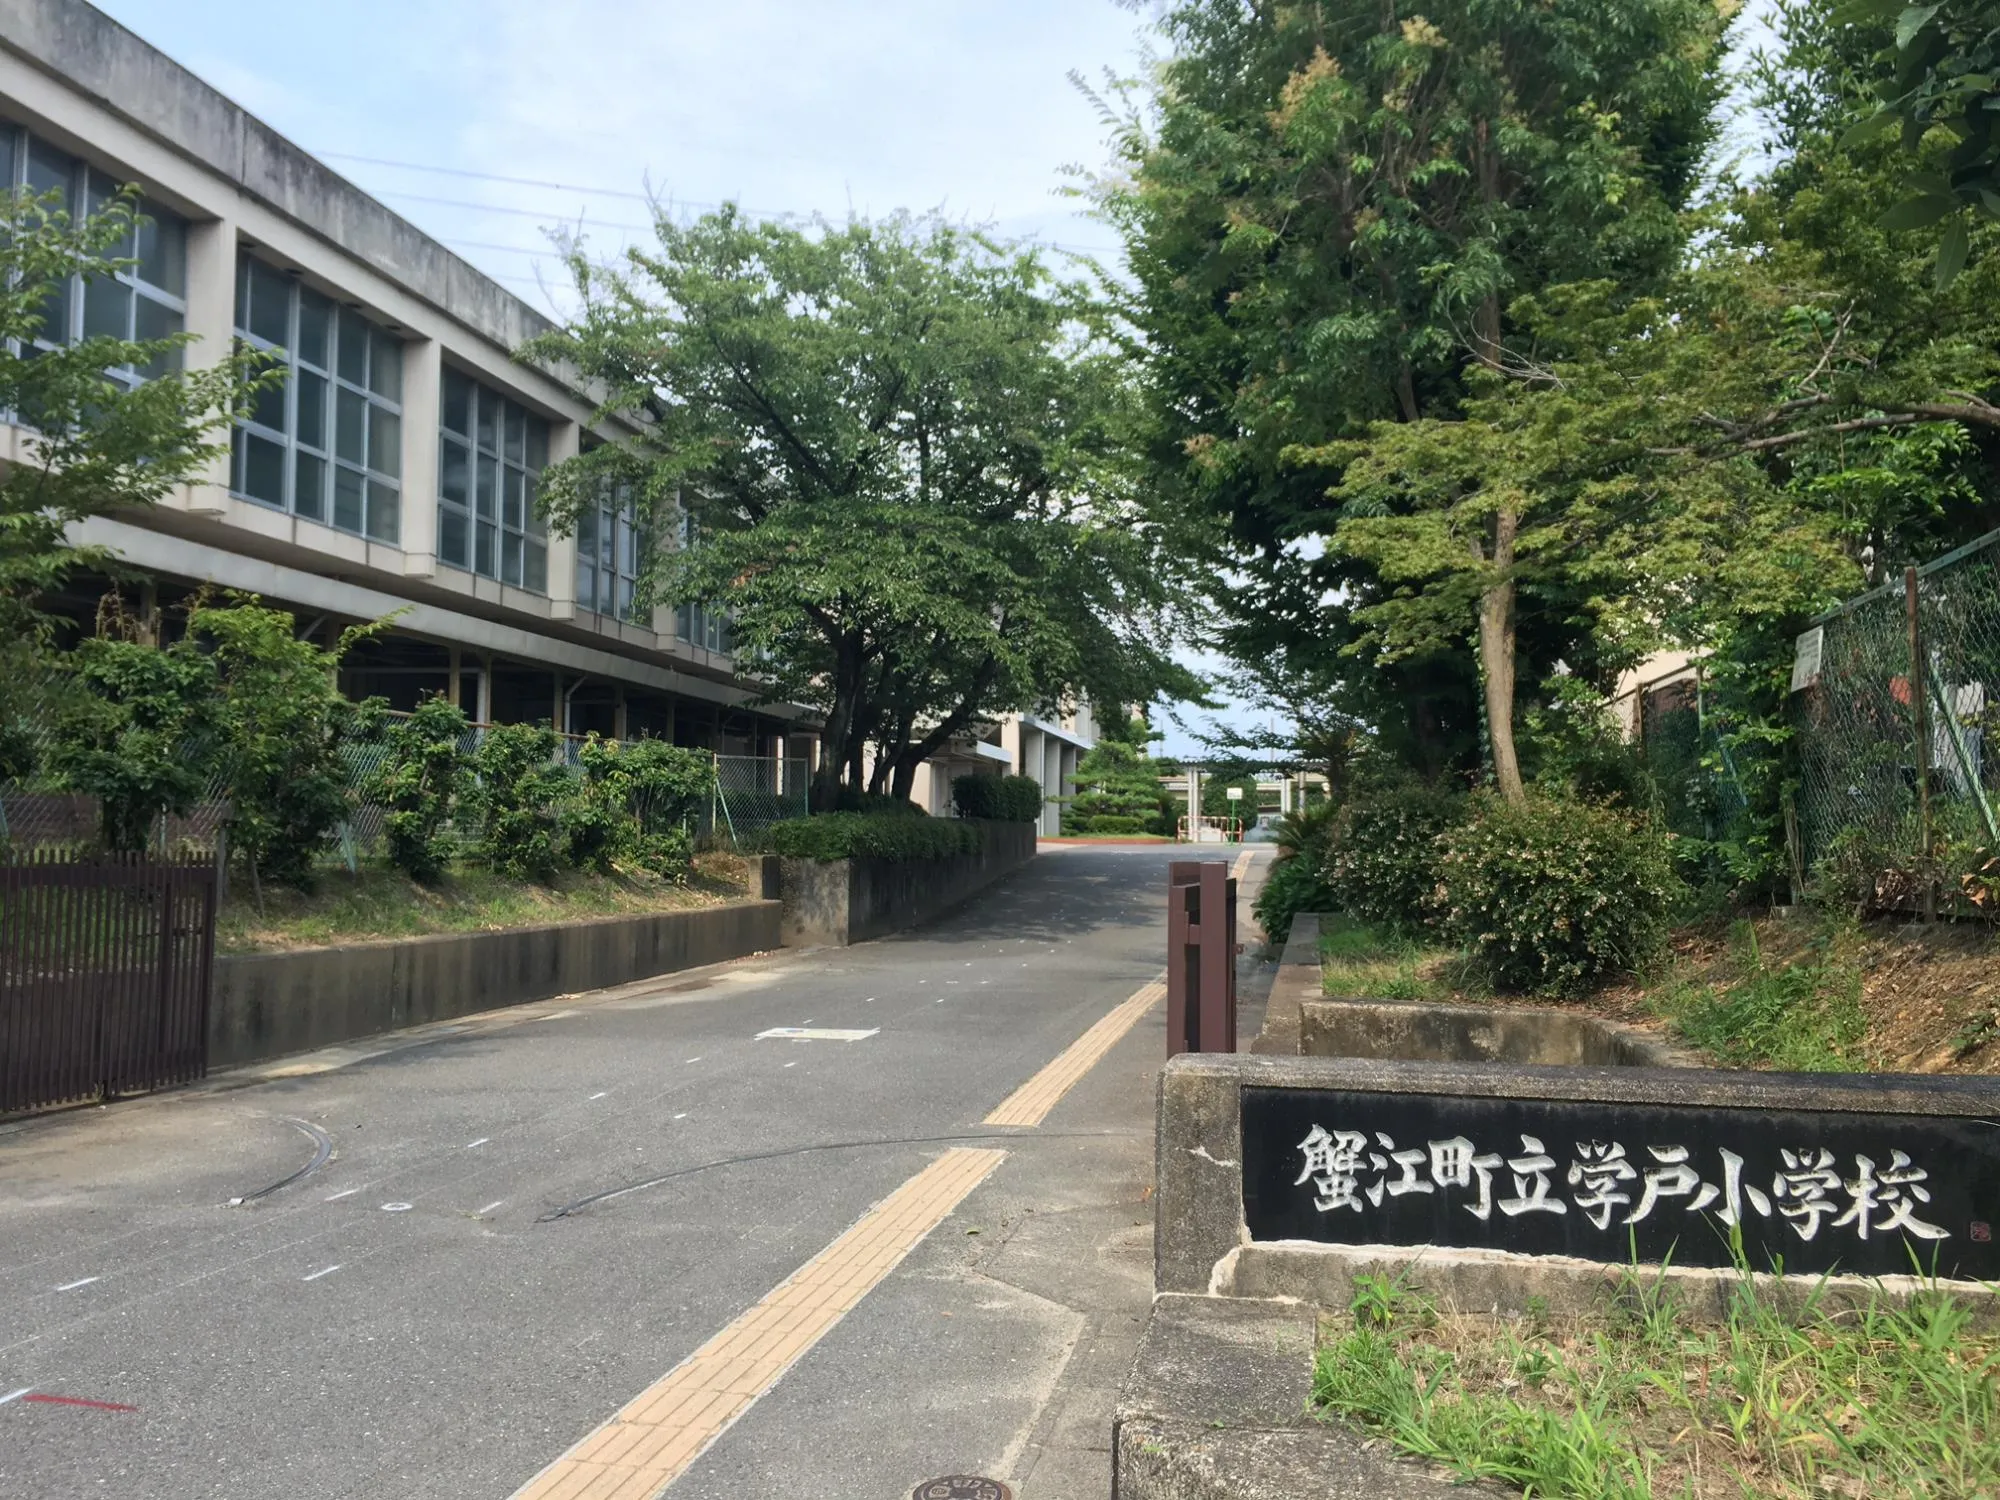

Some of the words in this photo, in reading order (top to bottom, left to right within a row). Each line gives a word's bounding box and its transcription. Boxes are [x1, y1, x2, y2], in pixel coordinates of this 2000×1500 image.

[1294, 1123, 1952, 1241] 蟹江町立学戸小学校
